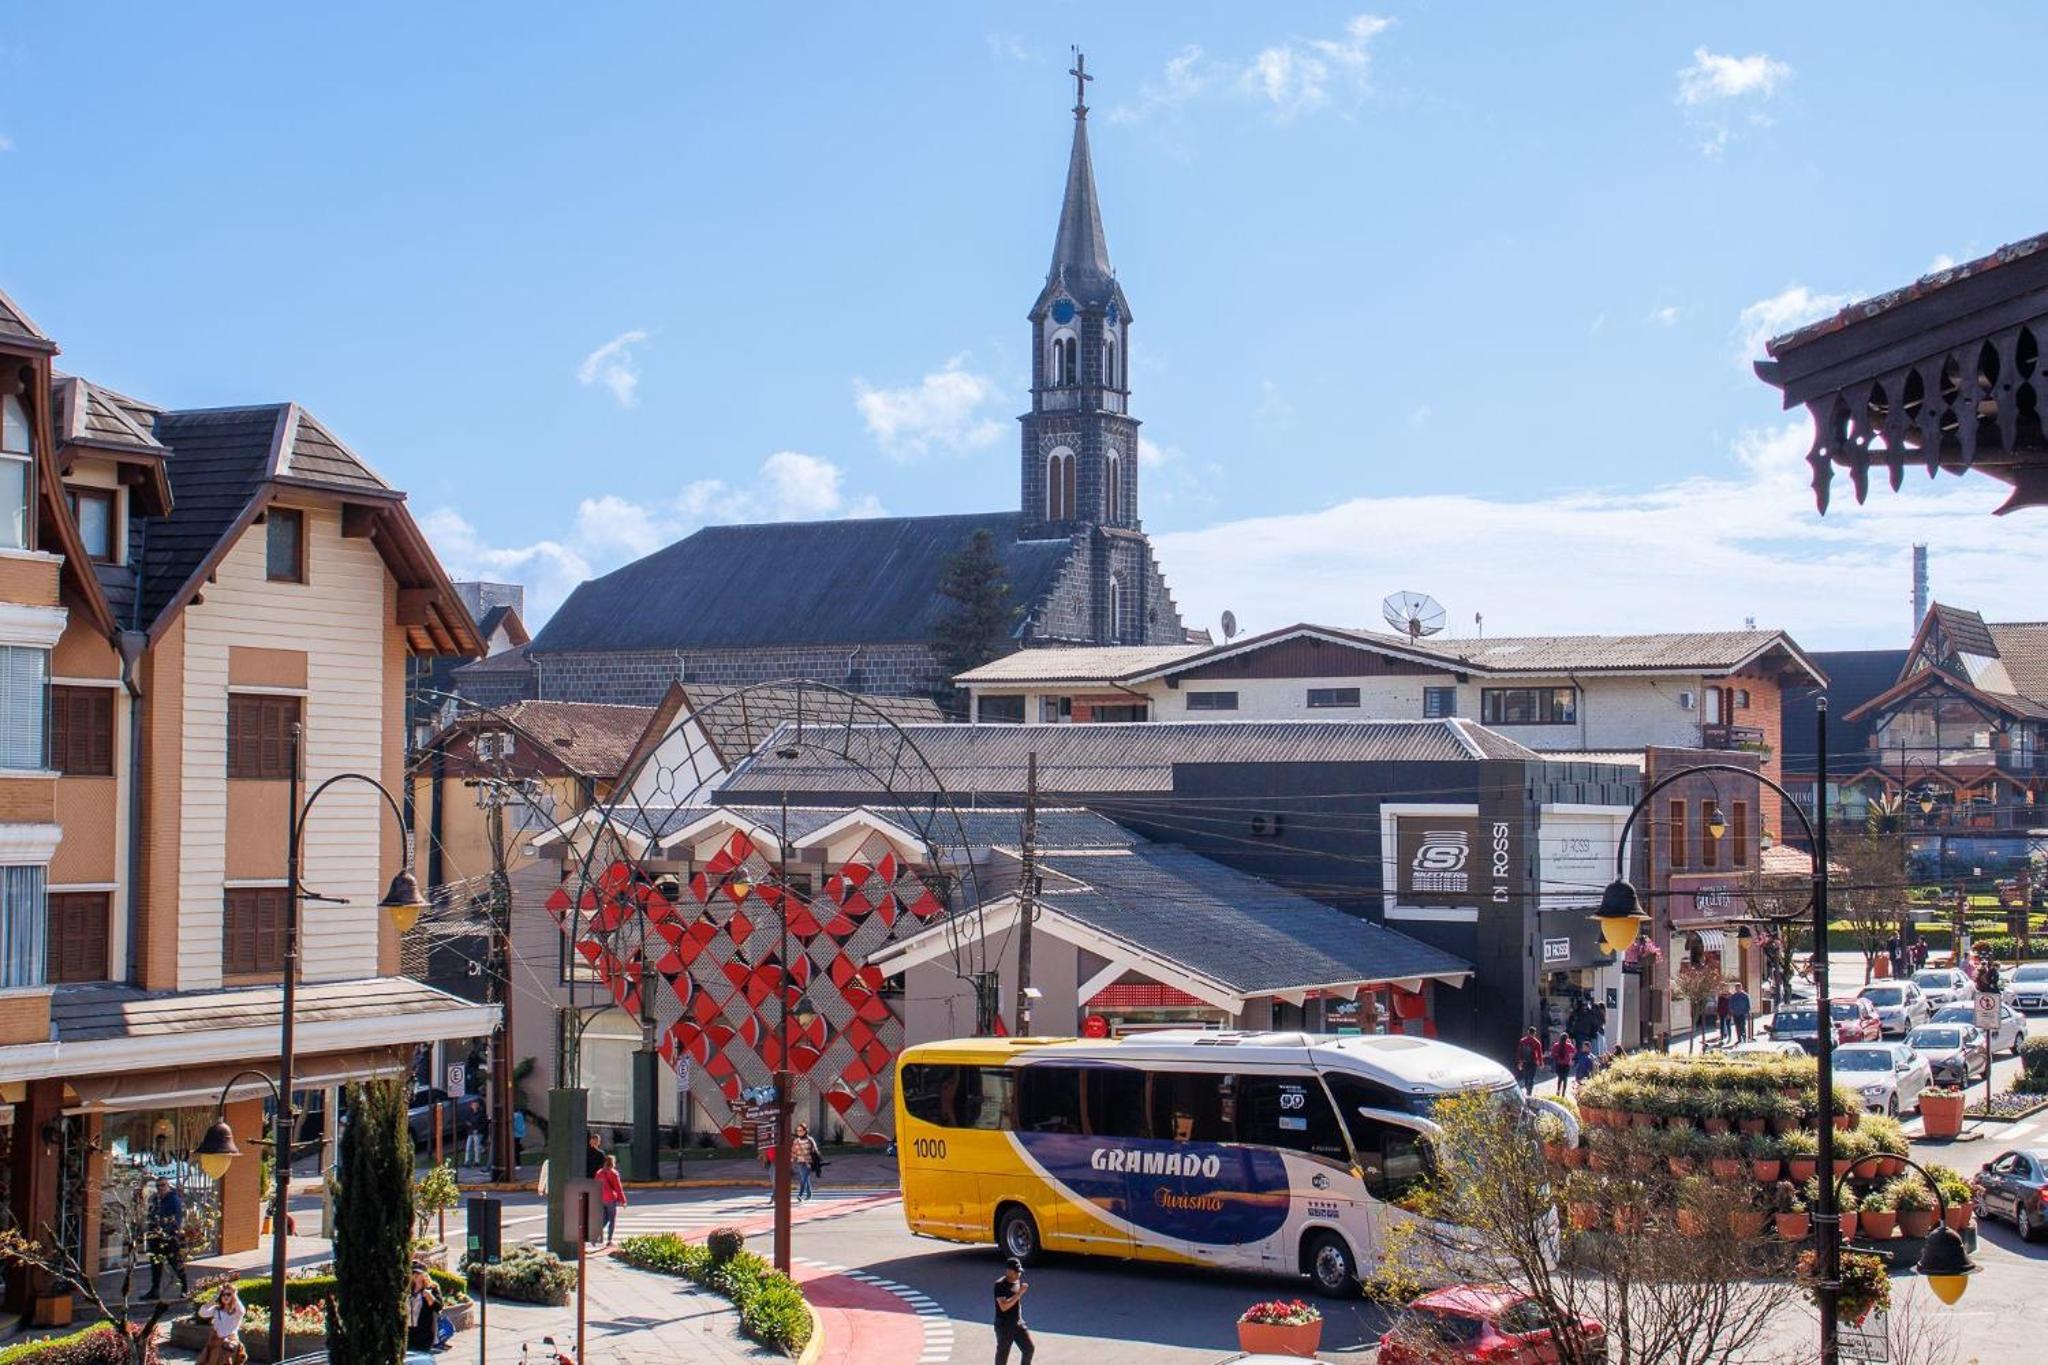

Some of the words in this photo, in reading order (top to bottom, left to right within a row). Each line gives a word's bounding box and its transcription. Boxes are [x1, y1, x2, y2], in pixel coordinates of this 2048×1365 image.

[1493, 822, 1508, 878] ROSSI
[1493, 886, 1508, 902] DI
[913, 1138, 946, 1159] 1000
[1091, 1148, 1220, 1178] GRAMADO
[1154, 1186, 1223, 1214] Turismo
